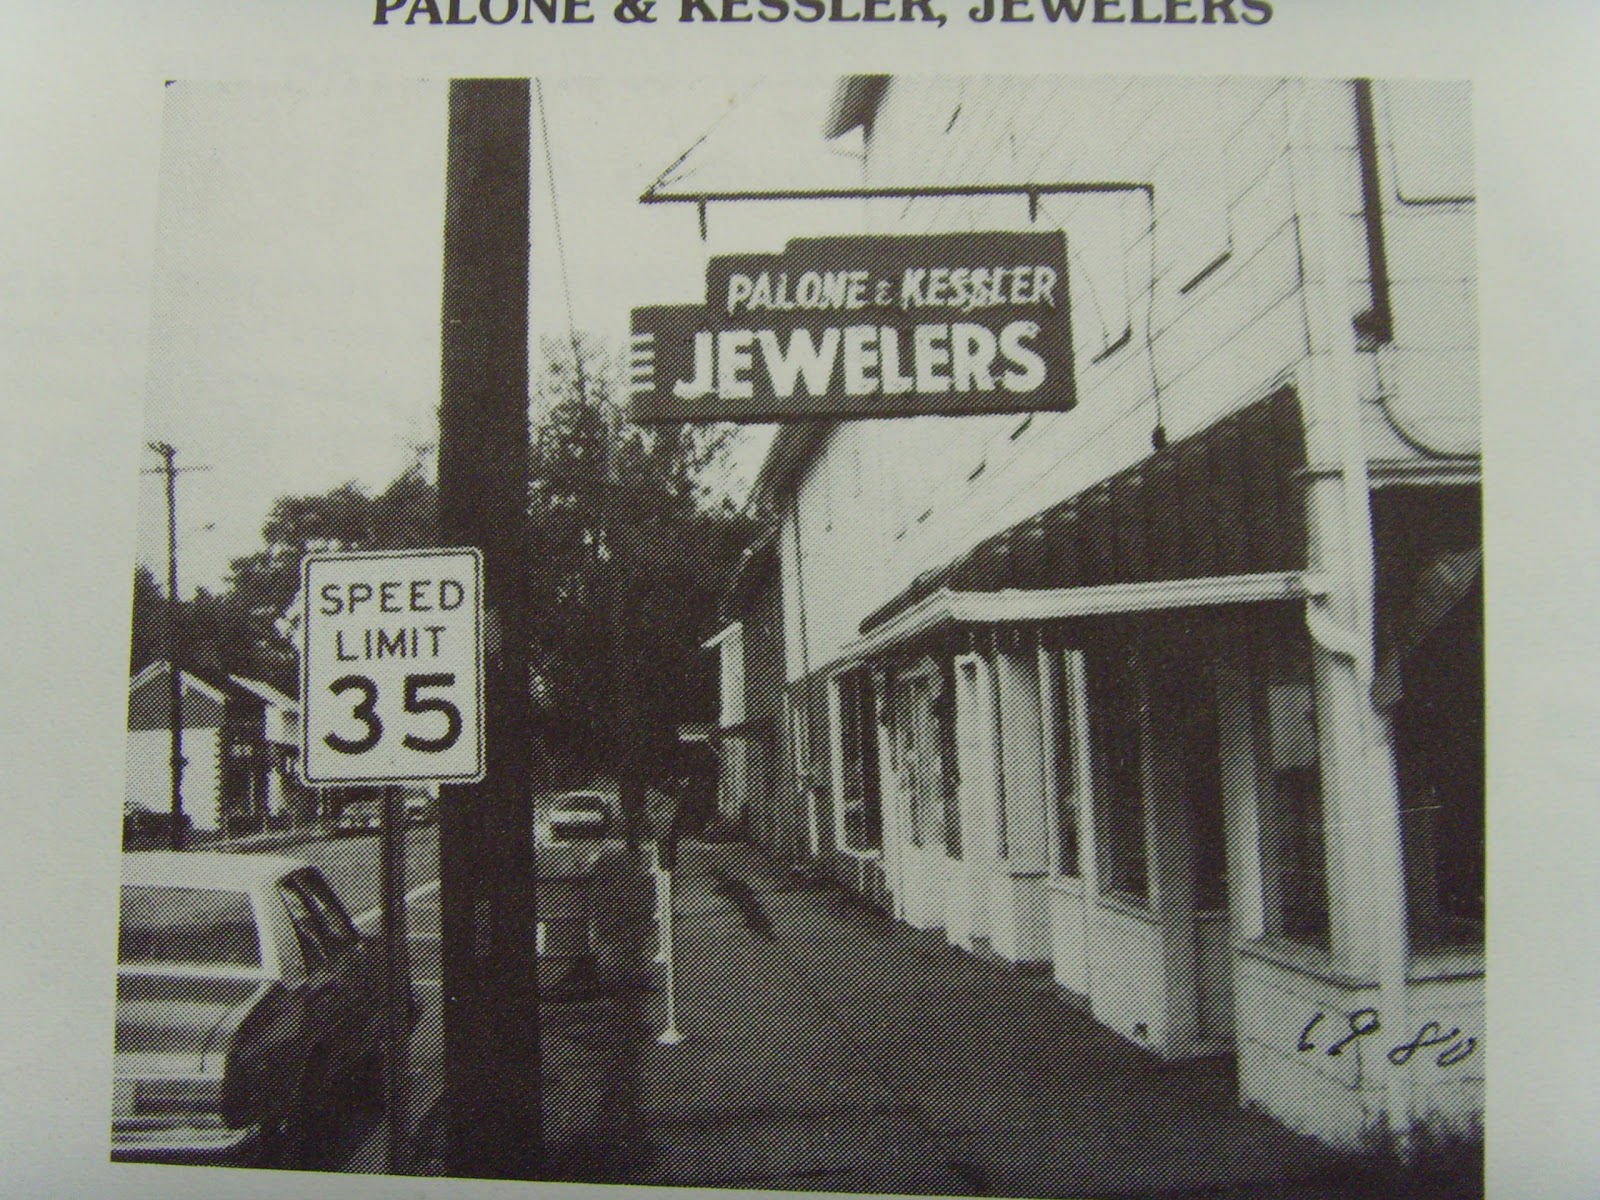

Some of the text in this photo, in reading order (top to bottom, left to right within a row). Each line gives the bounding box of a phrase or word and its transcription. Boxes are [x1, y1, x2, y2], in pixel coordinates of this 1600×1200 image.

[373, 0, 593, 25] PALONE
[615, 0, 658, 24] &
[968, 0, 1274, 25] JEWELERS
[728, 270, 870, 313] PALONE
[900, 264, 1058, 312] KESSLER
[673, 320, 1047, 398] JEWELERS
[320, 579, 465, 616] SPEED
[336, 625, 446, 661] LIMIT
[322, 672, 464, 756] 35
